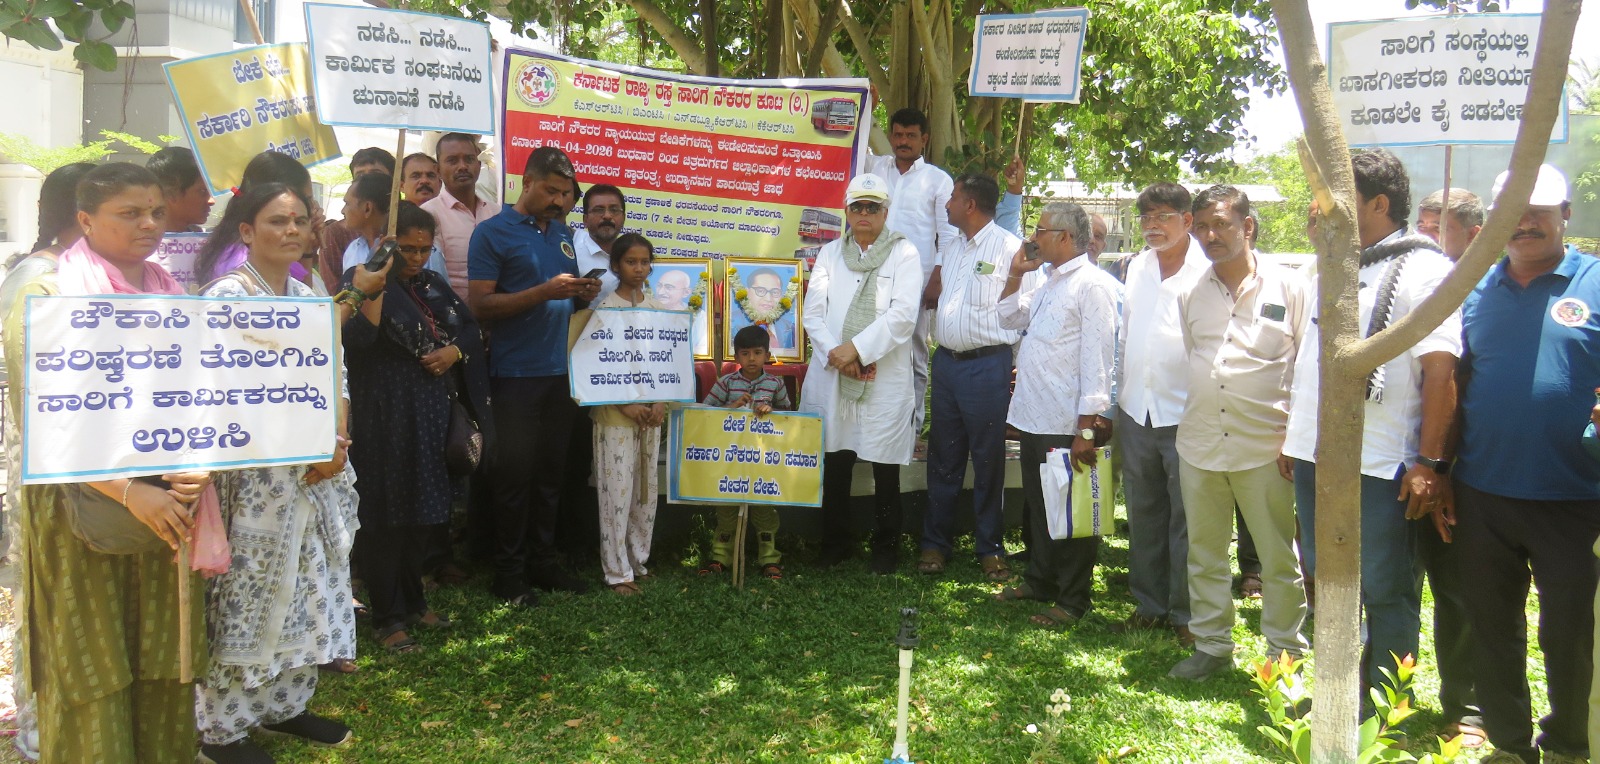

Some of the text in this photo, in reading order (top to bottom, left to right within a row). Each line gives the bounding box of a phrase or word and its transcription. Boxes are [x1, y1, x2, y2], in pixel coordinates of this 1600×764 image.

[357, 22, 471, 53] ನಡೆಸಿ... ನಡೆಸಿ....
[1381, 28, 1529, 63] ಸಾರಿಗೆ ಸಂಸ್ಥೆಯಲ್ಲಿ
[233, 56, 264, 84] ಬೇಕೆ
[325, 55, 482, 84] ಕಾರ್ಮಿಕ ಸಂಘಟನೆಯ
[987, 72, 1008, 91] ತಕ್ಕಂತೆ
[1339, 67, 1447, 93] ಖಾಸಗೀಕರಣ
[353, 87, 465, 112] ಚುನಾವಣೆ ನಡೆಸಿ
[573, 70, 621, 94] ಕರ್ನಾಟಕ
[625, 79, 650, 106] ರಾಜ್ಯ
[655, 82, 674, 107] ರಸ್ತೆ
[677, 86, 709, 105] ಸಾರಿಗೆ
[714, 86, 752, 109] ನೌಕರರ
[756, 92, 783, 112] ಕೂಟ
[788, 91, 810, 117] (ರಿ.)
[196, 108, 252, 139] ಸರ್ಕಾರಿ
[1351, 101, 1421, 126] ಕೂಡಲೇ
[1431, 99, 1450, 132] ಕೈ
[538, 119, 822, 162] ಸಾರಿಗೆ ನೌಕರರ ನ್ಯಾಯಯುತ ಬೇಡಿಕೆಗಳನ್ನು ಈಡೇರಿಸುವಂತೆ ಒತ್ತಾಯಿಸಿ
[511, 134, 543, 148] ದಿನಾಂಕ
[546, 139, 613, 158] 08-04-2026
[616, 148, 654, 162] ಬುಧವಾರ
[658, 151, 679, 164] ರಿಂದ
[682, 155, 729, 171] ಚಿತ್ರದುರ್ಗದ
[732, 160, 791, 177] ಜಿಲ್ಲಾಧಿಕಾರಿಗಳ
[624, 168, 661, 188] ಸ್ವಾತಂತ್ರ್ಯ
[665, 173, 712, 191] ಉದ್ಯಾನವನ
[715, 178, 760, 197] ಪಾದಯಾತ್ರೆ
[70, 301, 301, 330] ಚೌಕಾಸಿ ವೇತನ
[624, 325, 654, 340] ವೇತನ
[35, 343, 329, 383] ಪರಿಷ್ಕರಣೆ ತೊಲಗಿಸಿ
[649, 349, 673, 362] ಸಾರಿಗೆ
[590, 370, 681, 389] ಕಾರ್ಮಿಕರನ್ನು ಉಳಿಸಿ
[38, 381, 328, 413] ಸಾರಿಗೆ ಕಾರ್ಮಿಕರನ್ನು
[132, 422, 251, 453] ಉಳಿಸಿ
[723, 415, 746, 432] ಬೇಕೆ
[685, 444, 817, 468] ಸರ್ಕಾರಿ ನೌಕರರ ಸರಿ ಸಮಾನ
[719, 476, 780, 495] ವೇತನ ಬೇಕು.
